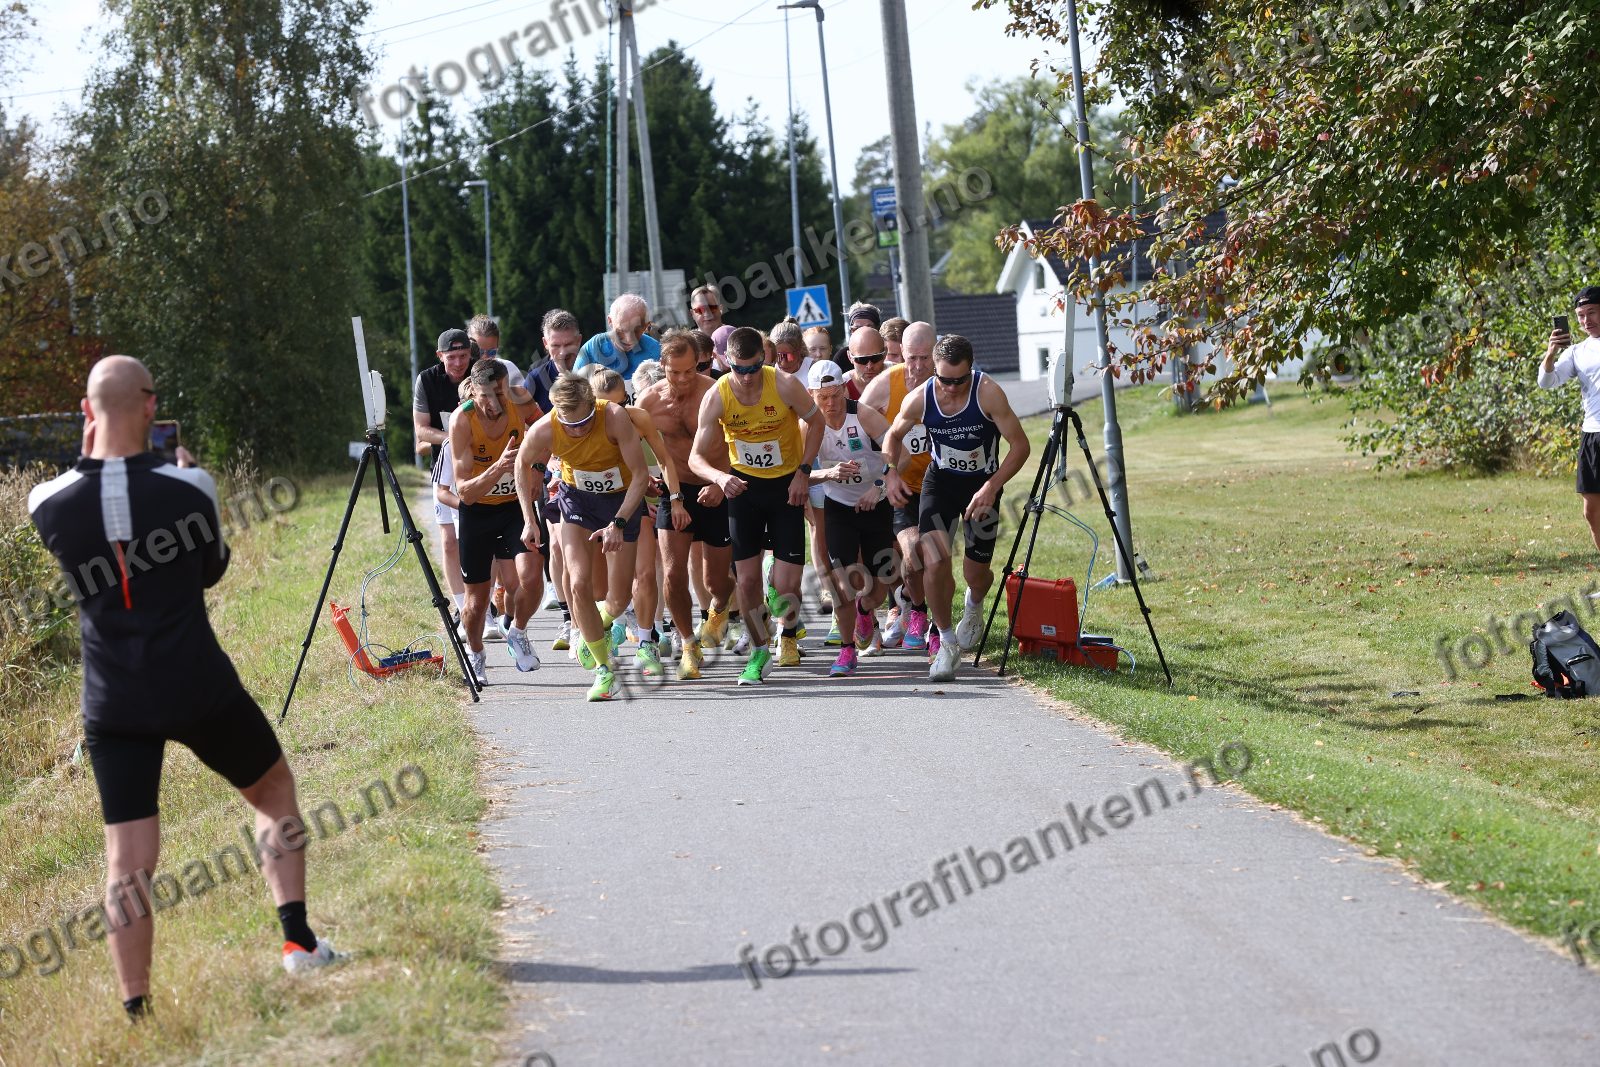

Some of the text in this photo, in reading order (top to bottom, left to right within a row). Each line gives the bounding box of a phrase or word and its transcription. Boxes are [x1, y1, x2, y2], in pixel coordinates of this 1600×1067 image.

[928, 423, 984, 435] SPAREBANKEN
[949, 433, 966, 441] SØR
[744, 452, 774, 467] 942
[948, 457, 978, 471] 993
[491, 479, 518, 495] 252
[583, 479, 615, 492] 992
